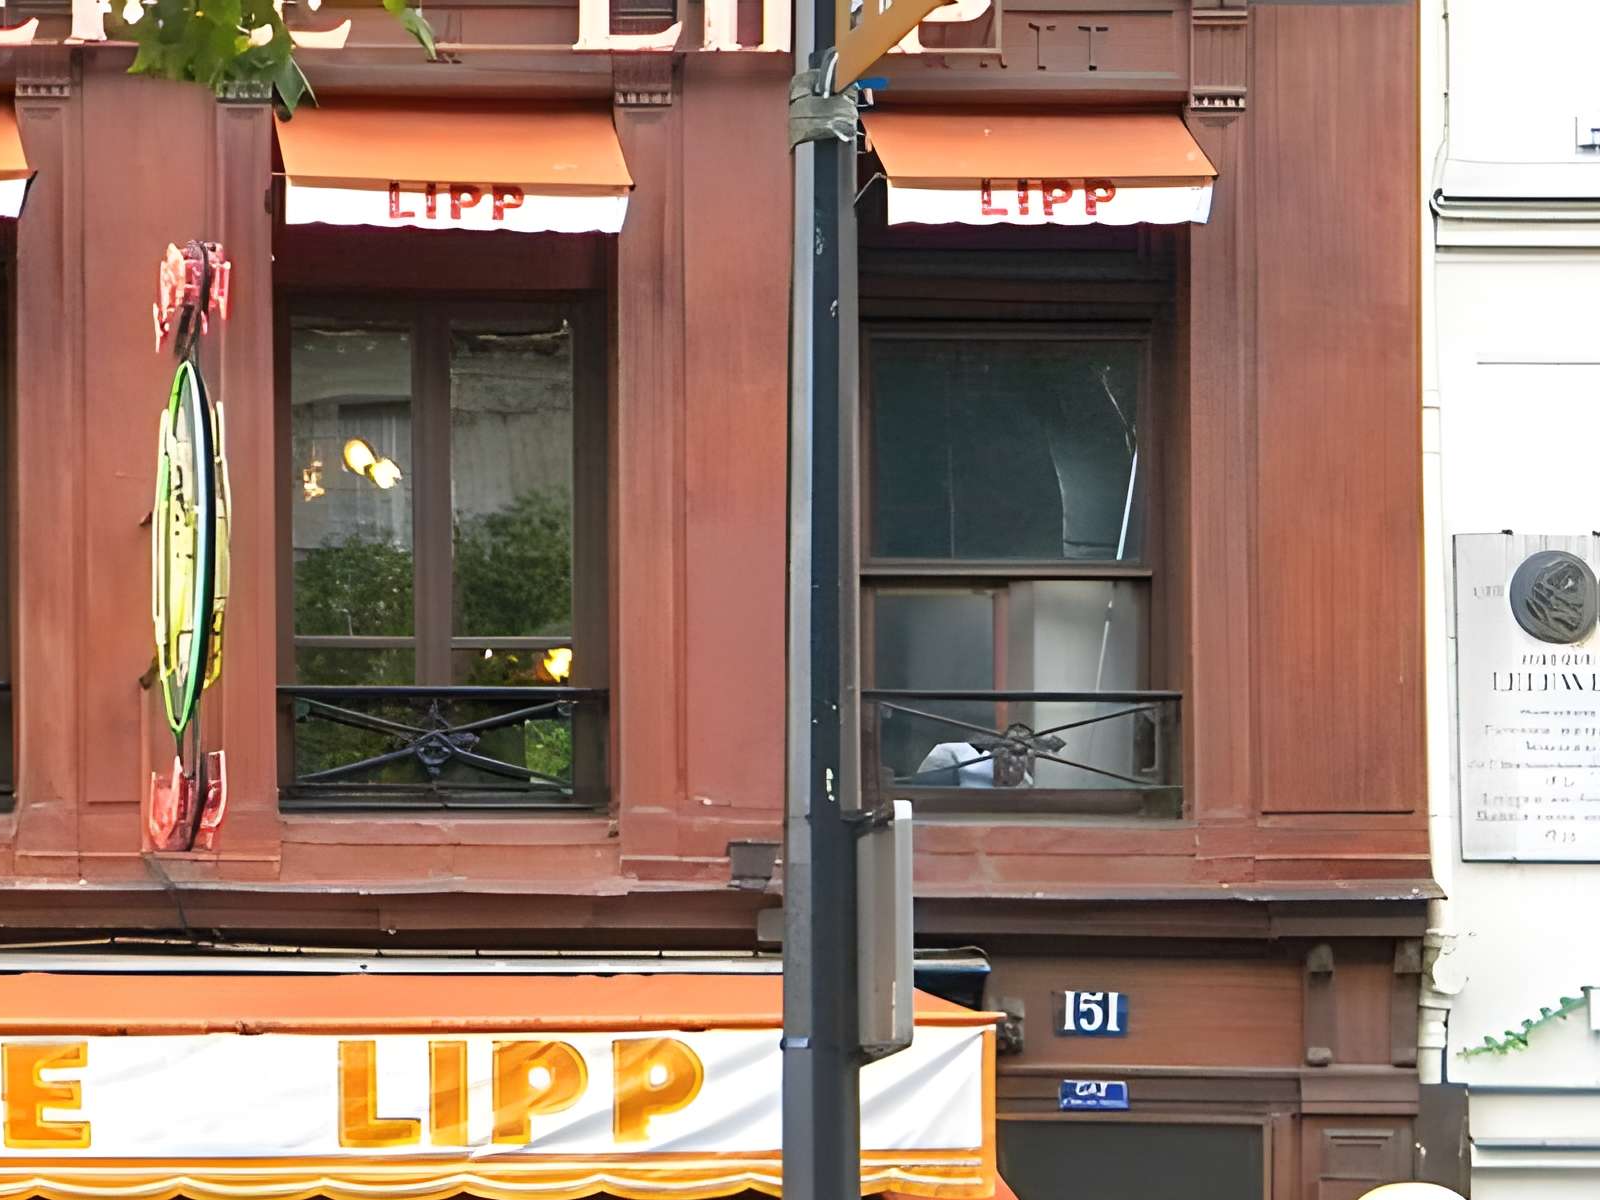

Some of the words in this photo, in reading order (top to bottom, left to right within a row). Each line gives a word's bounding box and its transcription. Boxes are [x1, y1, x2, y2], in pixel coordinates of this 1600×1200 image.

[387, 182, 525, 222] LIPP
[980, 178, 1117, 219] LIPP
[1063, 990, 1121, 1032] 151
[337, 1039, 705, 1149] LIPP
